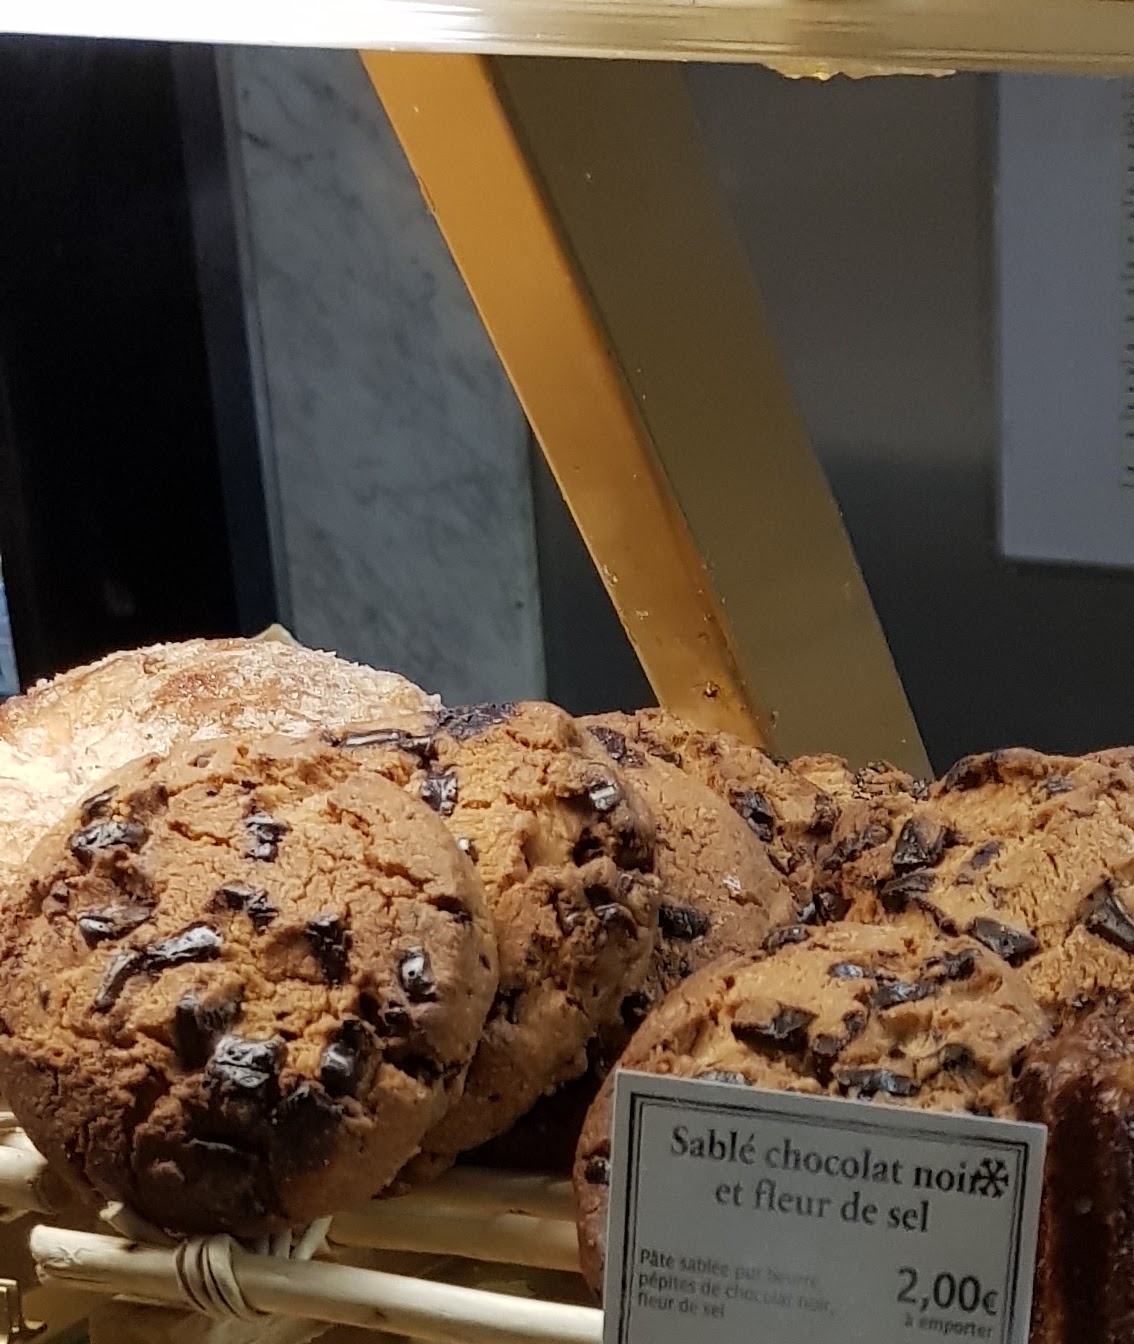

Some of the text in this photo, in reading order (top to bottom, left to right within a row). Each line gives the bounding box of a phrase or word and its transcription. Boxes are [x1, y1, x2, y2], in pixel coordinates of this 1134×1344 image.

[671, 1125, 980, 1195] Sablé chocolat noir
[715, 1178, 930, 1232] et fleur de sel
[897, 1266, 999, 1317] 2,00€
[918, 1316, 993, 1338] emporter
